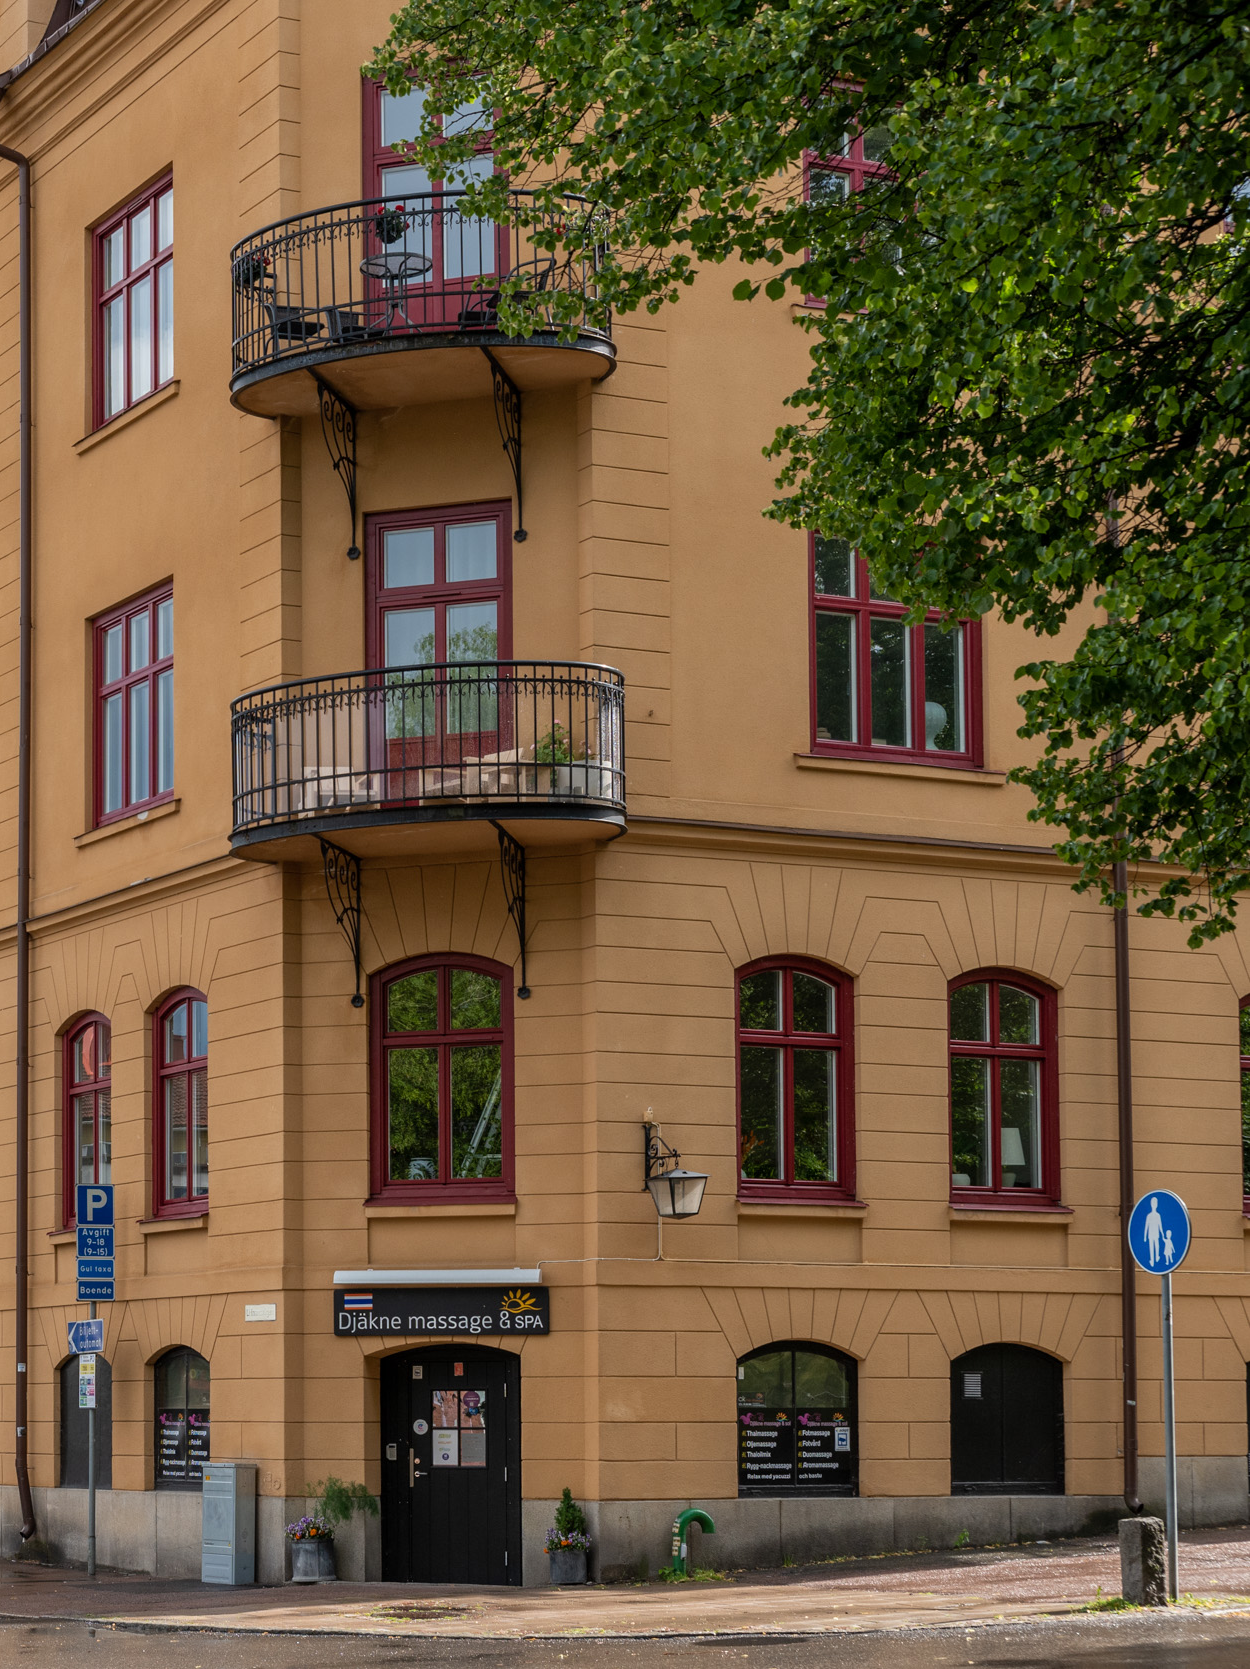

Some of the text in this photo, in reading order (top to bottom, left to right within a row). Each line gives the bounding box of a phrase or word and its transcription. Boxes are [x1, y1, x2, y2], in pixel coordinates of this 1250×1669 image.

[86, 1188, 108, 1222] P
[82, 1228, 110, 1238] Avgift
[86, 1238, 105, 1246] 9-18
[84, 1248, 108, 1256] (9-15)
[80, 1286, 112, 1294] Boende
[338, 1310, 544, 1334] Djäkne massage & SPA
[80, 1338, 102, 1349] automat
